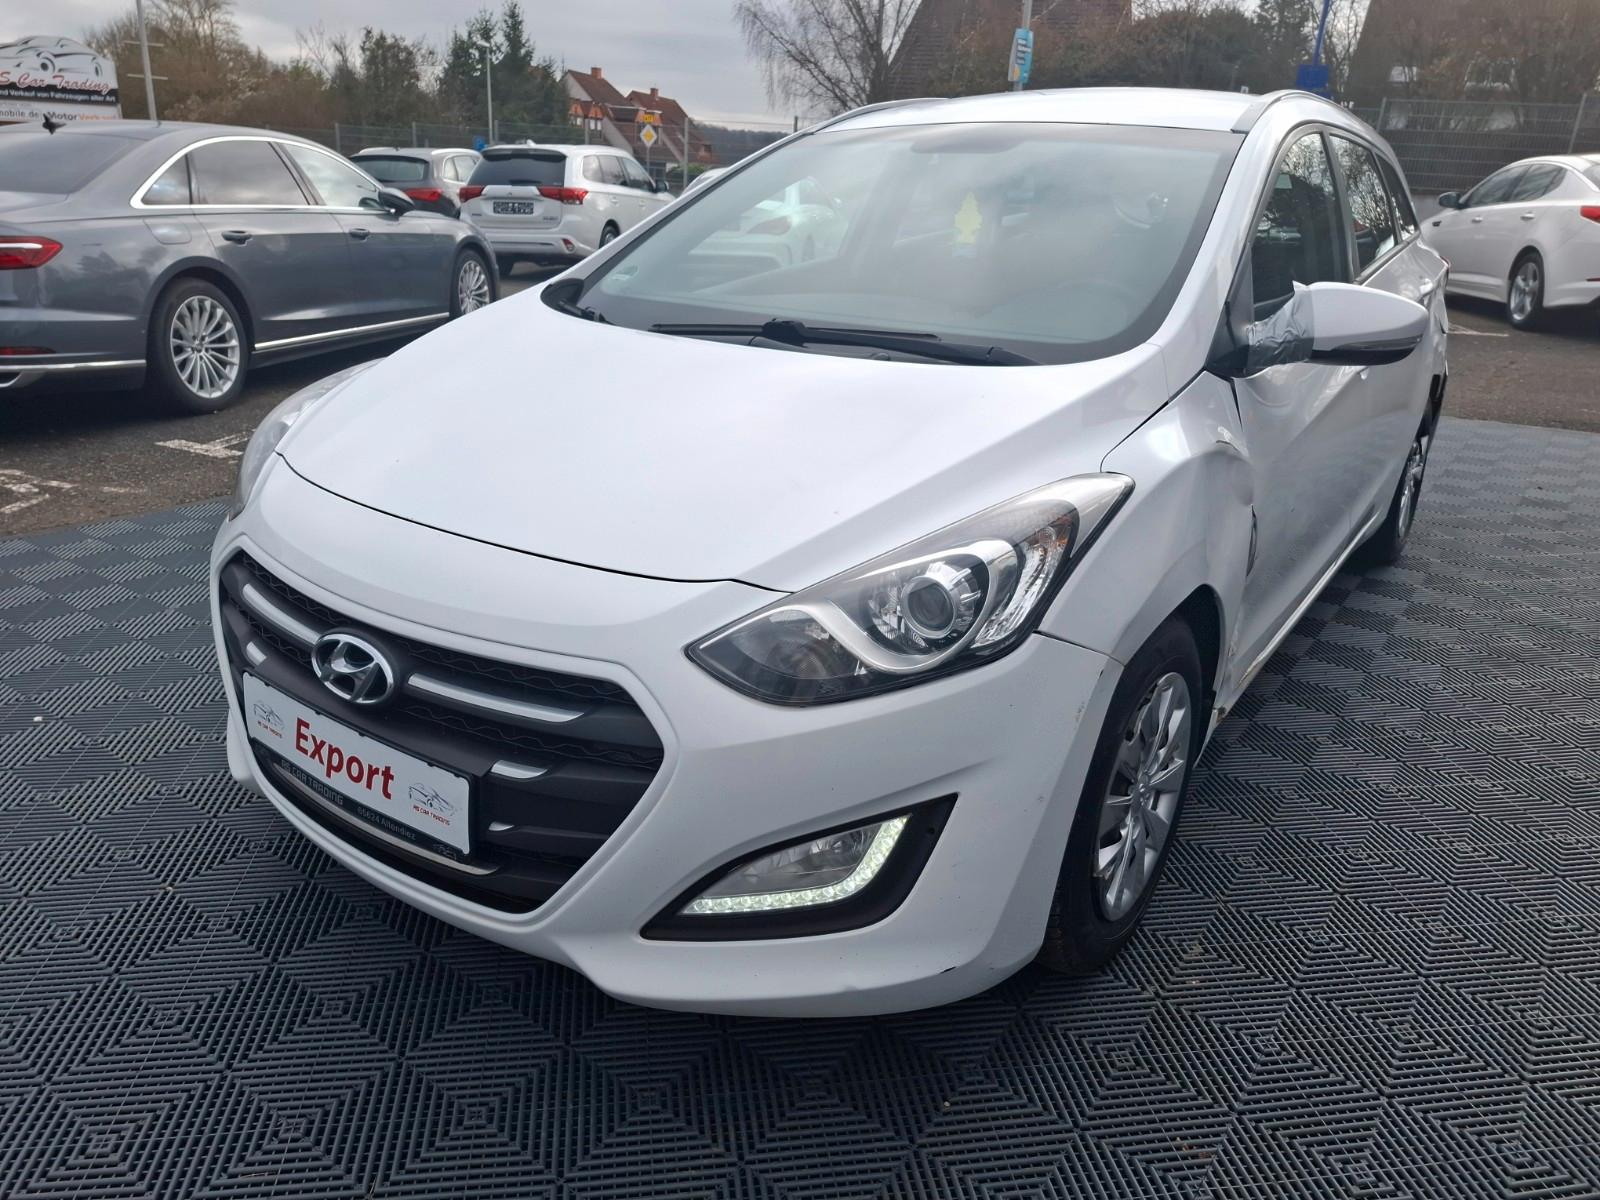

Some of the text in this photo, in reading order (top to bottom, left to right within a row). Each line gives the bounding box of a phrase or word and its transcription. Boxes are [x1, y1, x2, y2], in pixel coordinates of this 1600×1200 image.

[16, 72, 48, 88] Car
[52, 74, 111, 95] Trading
[295, 717, 395, 800] Export
